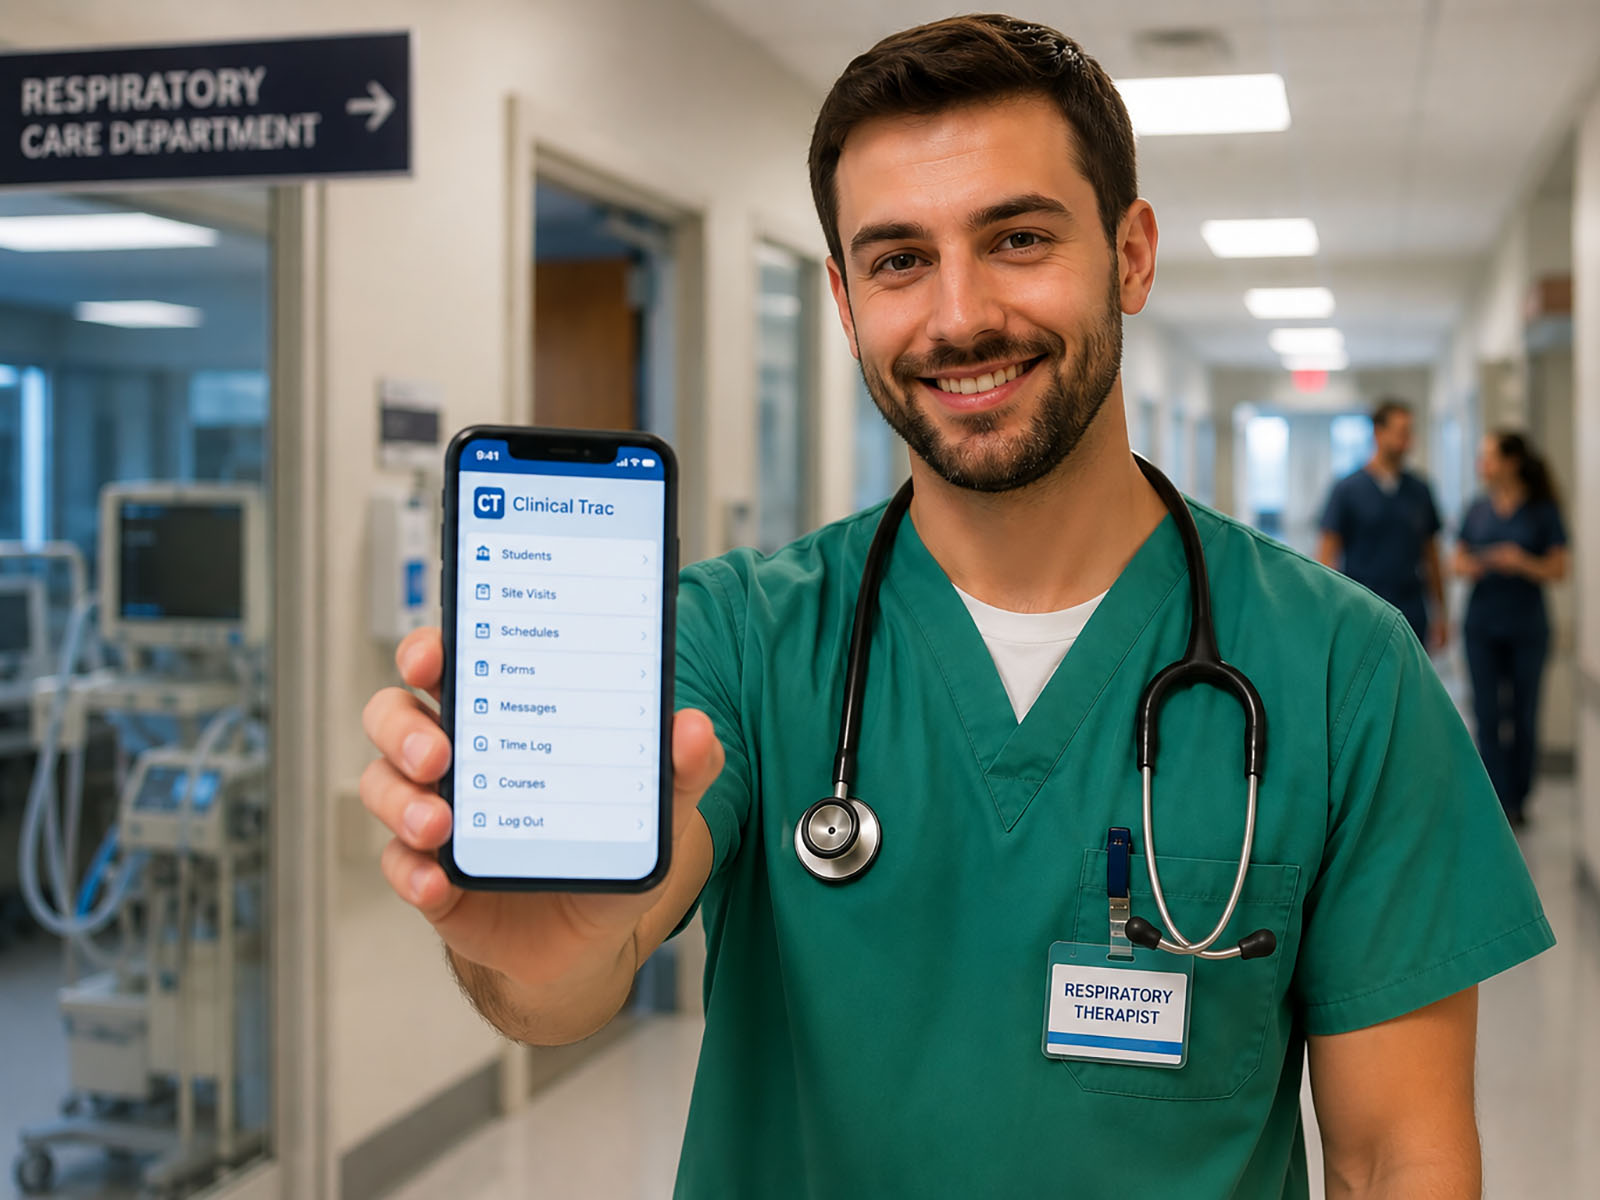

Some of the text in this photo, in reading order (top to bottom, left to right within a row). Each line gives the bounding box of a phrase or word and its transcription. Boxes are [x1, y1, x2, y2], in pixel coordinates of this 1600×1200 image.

[21, 66, 267, 116] RESPIRATORY
[21, 112, 322, 159] CARE DEPARTMENT
[476, 450, 499, 462] 9:41
[477, 494, 502, 512] CT
[513, 496, 614, 516] Clinical Trac
[501, 549, 552, 562] Students
[501, 588, 557, 600] Site Visits
[501, 626, 559, 638] Schedules
[500, 664, 535, 676] Forms
[500, 701, 557, 716] Messages
[500, 739, 552, 754] Time Log
[499, 777, 546, 789] Courses
[498, 816, 544, 828] Log Out
[1064, 983, 1174, 1004] RESPIRATORY
[1074, 1004, 1160, 1025] THERAPIST
